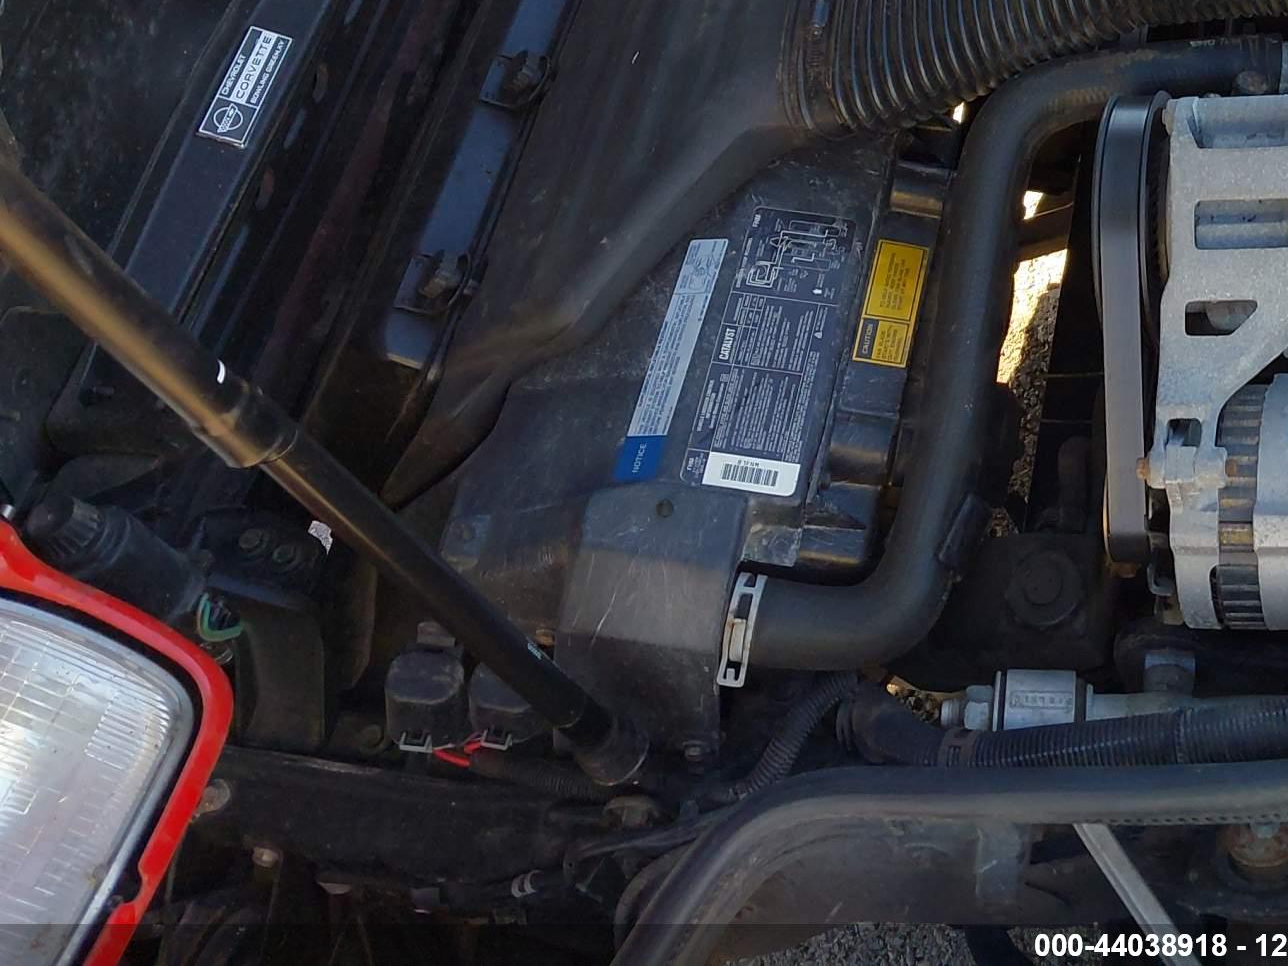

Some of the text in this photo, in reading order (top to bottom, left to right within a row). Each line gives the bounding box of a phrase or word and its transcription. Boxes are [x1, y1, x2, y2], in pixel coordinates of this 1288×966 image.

[221, 52, 246, 95] CHEVROLET
[234, 34, 273, 99] CORVETTE
[249, 71, 270, 104] BOWLING
[719, 326, 736, 360] CATALYST
[861, 322, 873, 354] CAUTION
[630, 441, 648, 474] NOTICE
